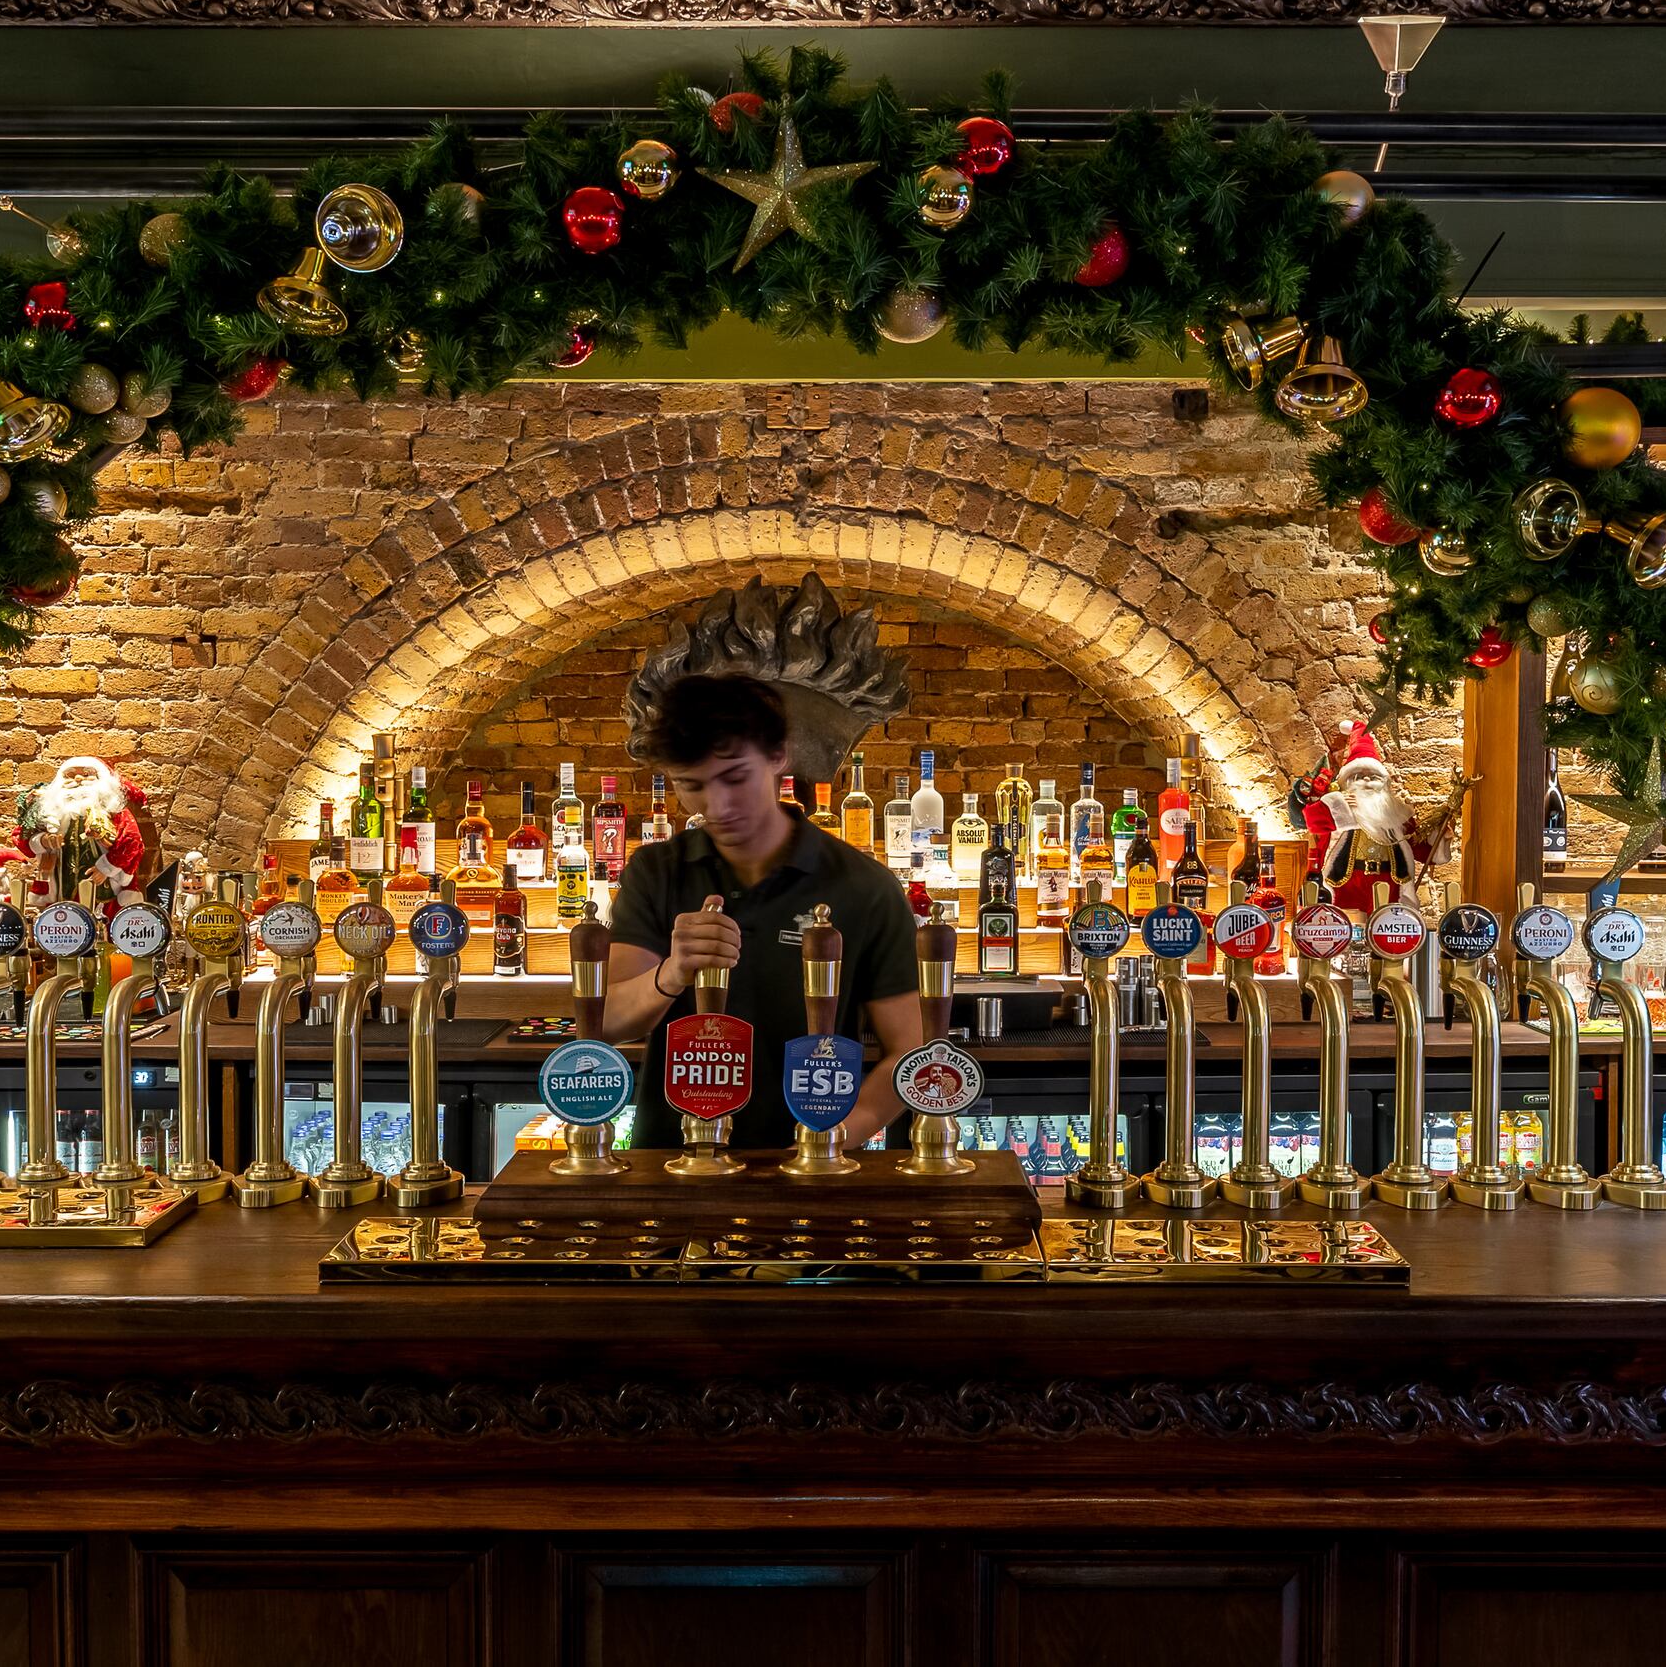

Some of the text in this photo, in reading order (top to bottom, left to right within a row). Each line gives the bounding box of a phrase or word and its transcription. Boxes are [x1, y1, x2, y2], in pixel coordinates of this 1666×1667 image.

[311, 859, 330, 868] JAME
[357, 852, 371, 864] 12
[1153, 918, 1193, 929] LUCKY
[1228, 914, 1260, 936] JUBEL
[1376, 923, 1417, 933] AMSTEL
[40, 925, 82, 935] PERONI
[120, 926, 155, 939] Asahi
[269, 927, 310, 935] CORNISH
[338, 925, 389, 939] NECK OIL
[1153, 929, 1193, 942] SAINT
[1297, 927, 1349, 938] Cruzcampo
[1524, 928, 1567, 937] PERONI
[1077, 933, 1121, 941] BRIXTON
[1235, 932, 1255, 946] BEER
[1444, 935, 1493, 946] GUINNESS
[1600, 930, 1635, 943] Asahi
[689, 1041, 731, 1049] FULLER'S
[673, 1051, 745, 1063] LONDON
[804, 1059, 842, 1067] FULLER'S
[672, 1064, 745, 1086] PRIDE
[900, 1051, 978, 1088] TIMOTHY TAYLOR'S
[550, 1075, 622, 1090] SEAFARERS
[791, 1069, 854, 1096] ESB
[681, 1089, 733, 1100] Outstanding
[906, 1086, 969, 1108] GOLDEN BEST
[1527, 1095, 1549, 1103] Gam
